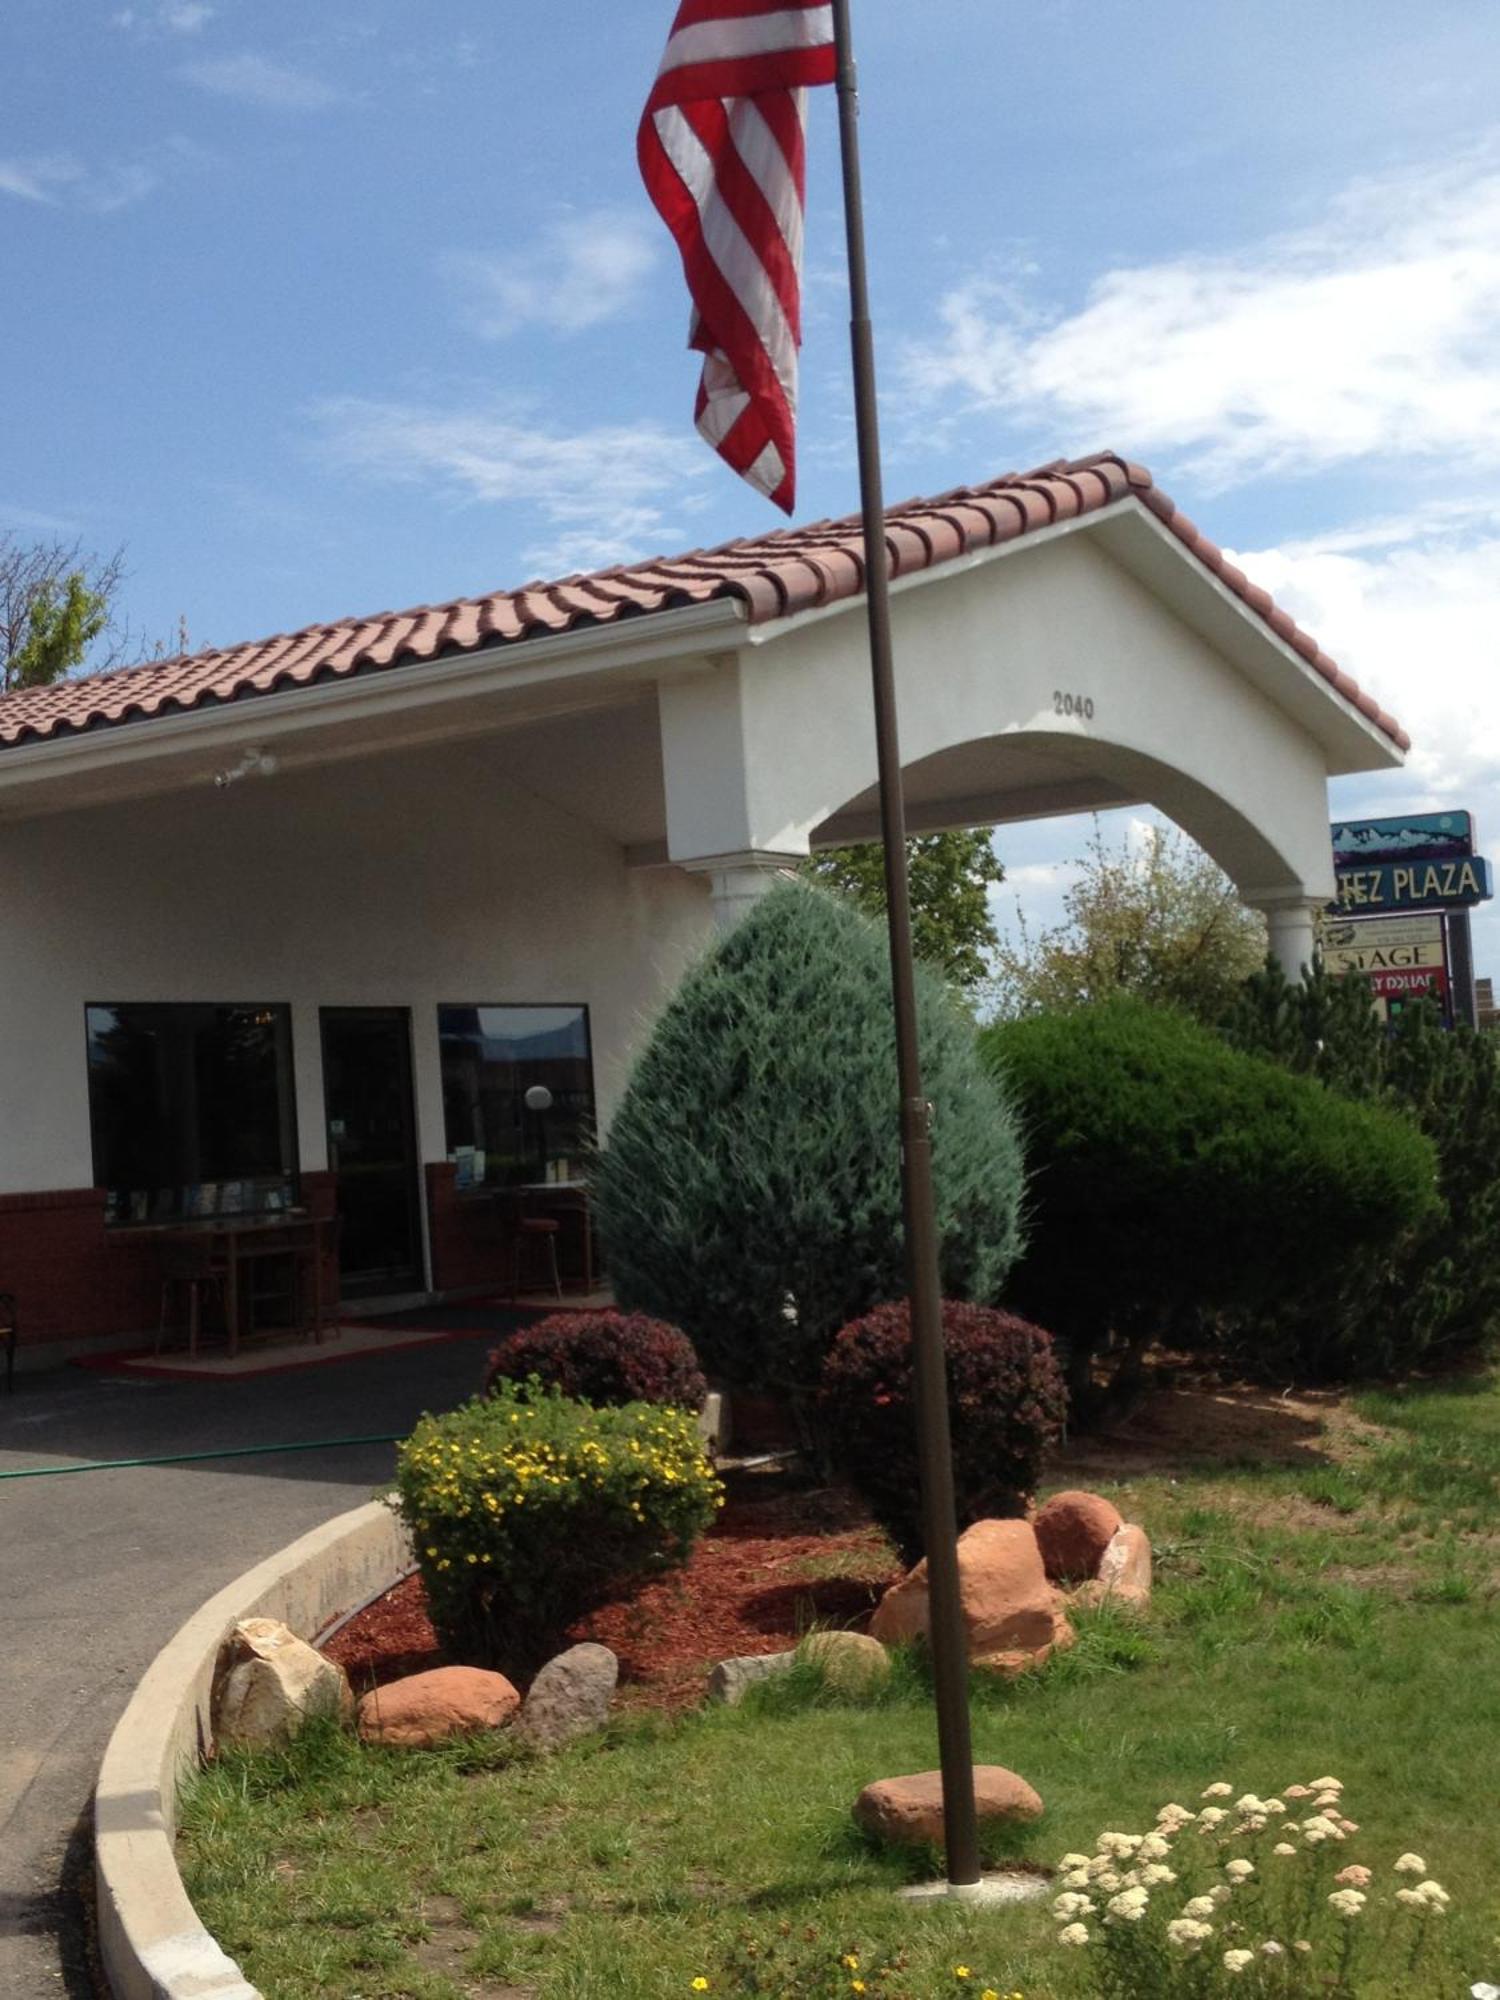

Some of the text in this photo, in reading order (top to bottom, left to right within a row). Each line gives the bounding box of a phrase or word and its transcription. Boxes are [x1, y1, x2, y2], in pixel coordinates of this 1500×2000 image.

[1053, 690, 1094, 719] 2040
[1393, 861, 1479, 900] PLAZA
[1338, 947, 1428, 971] STAGE
